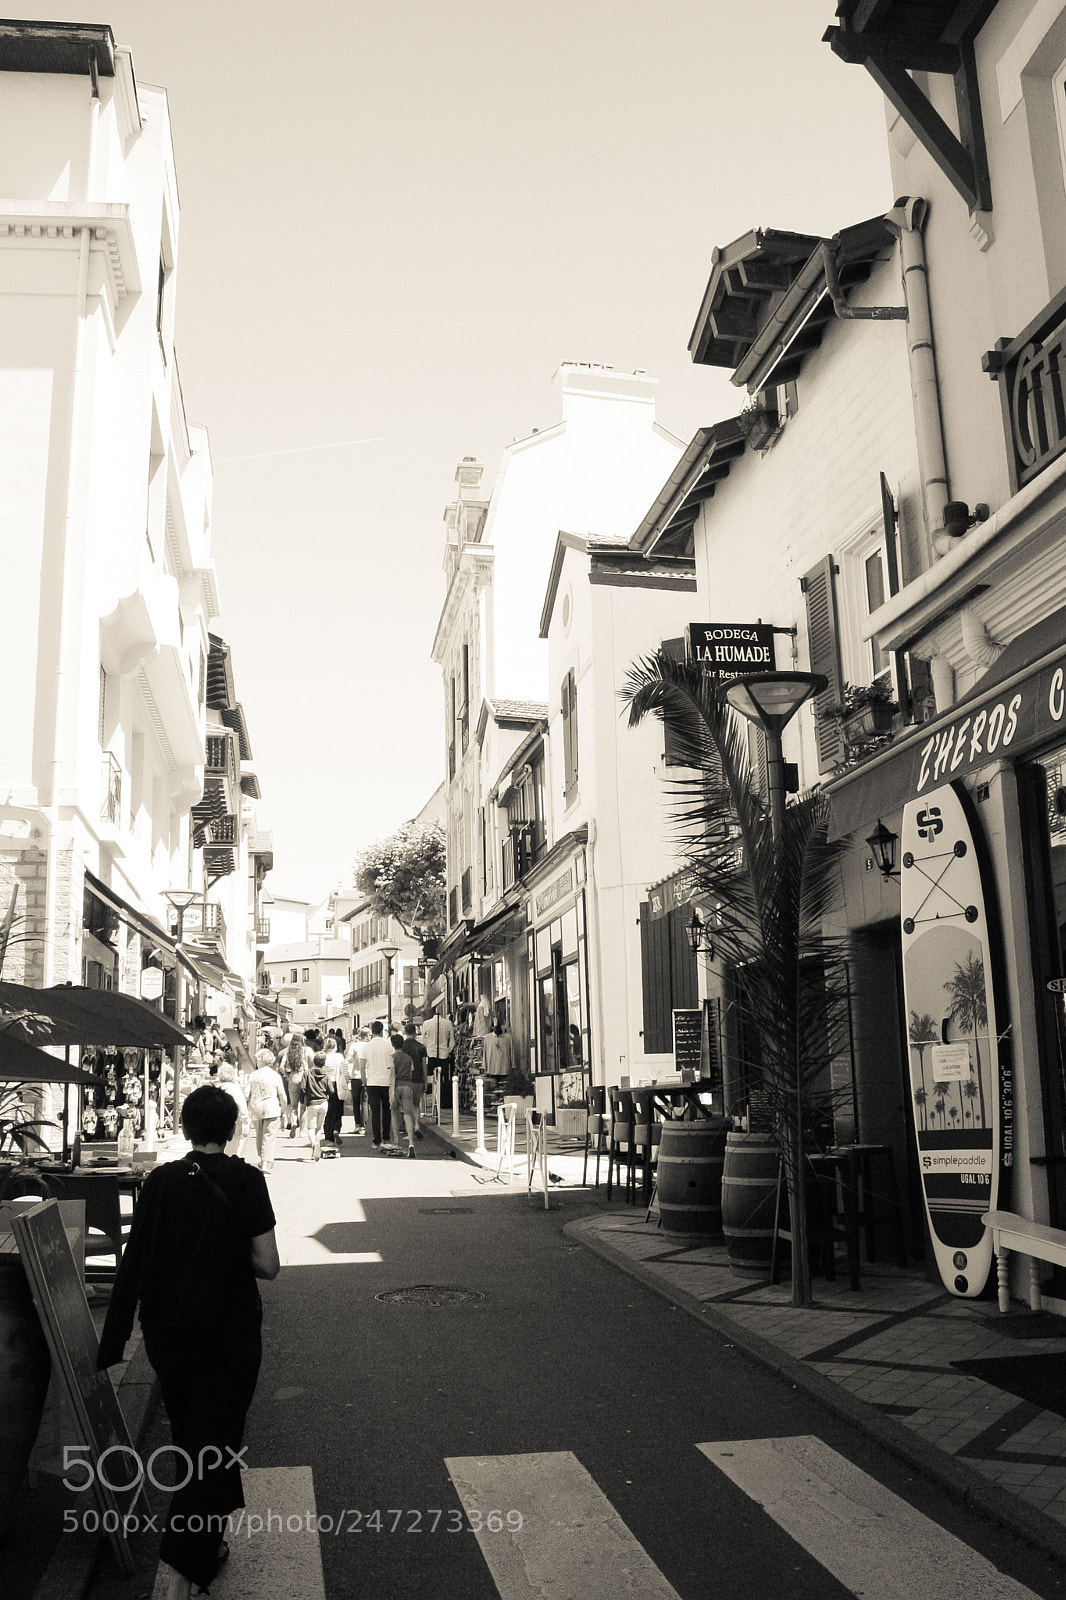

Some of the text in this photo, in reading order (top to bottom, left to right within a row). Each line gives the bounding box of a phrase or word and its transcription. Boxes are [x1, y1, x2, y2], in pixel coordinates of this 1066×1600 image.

[704, 629, 759, 642] BODEGA
[696, 645, 771, 662] LA HUMADE
[916, 693, 1022, 792] Z'HEROS
[1003, 1122, 1013, 1150] UGAL
[933, 1155, 986, 1167] simplepaddle
[960, 1173, 976, 1184] UGAL
